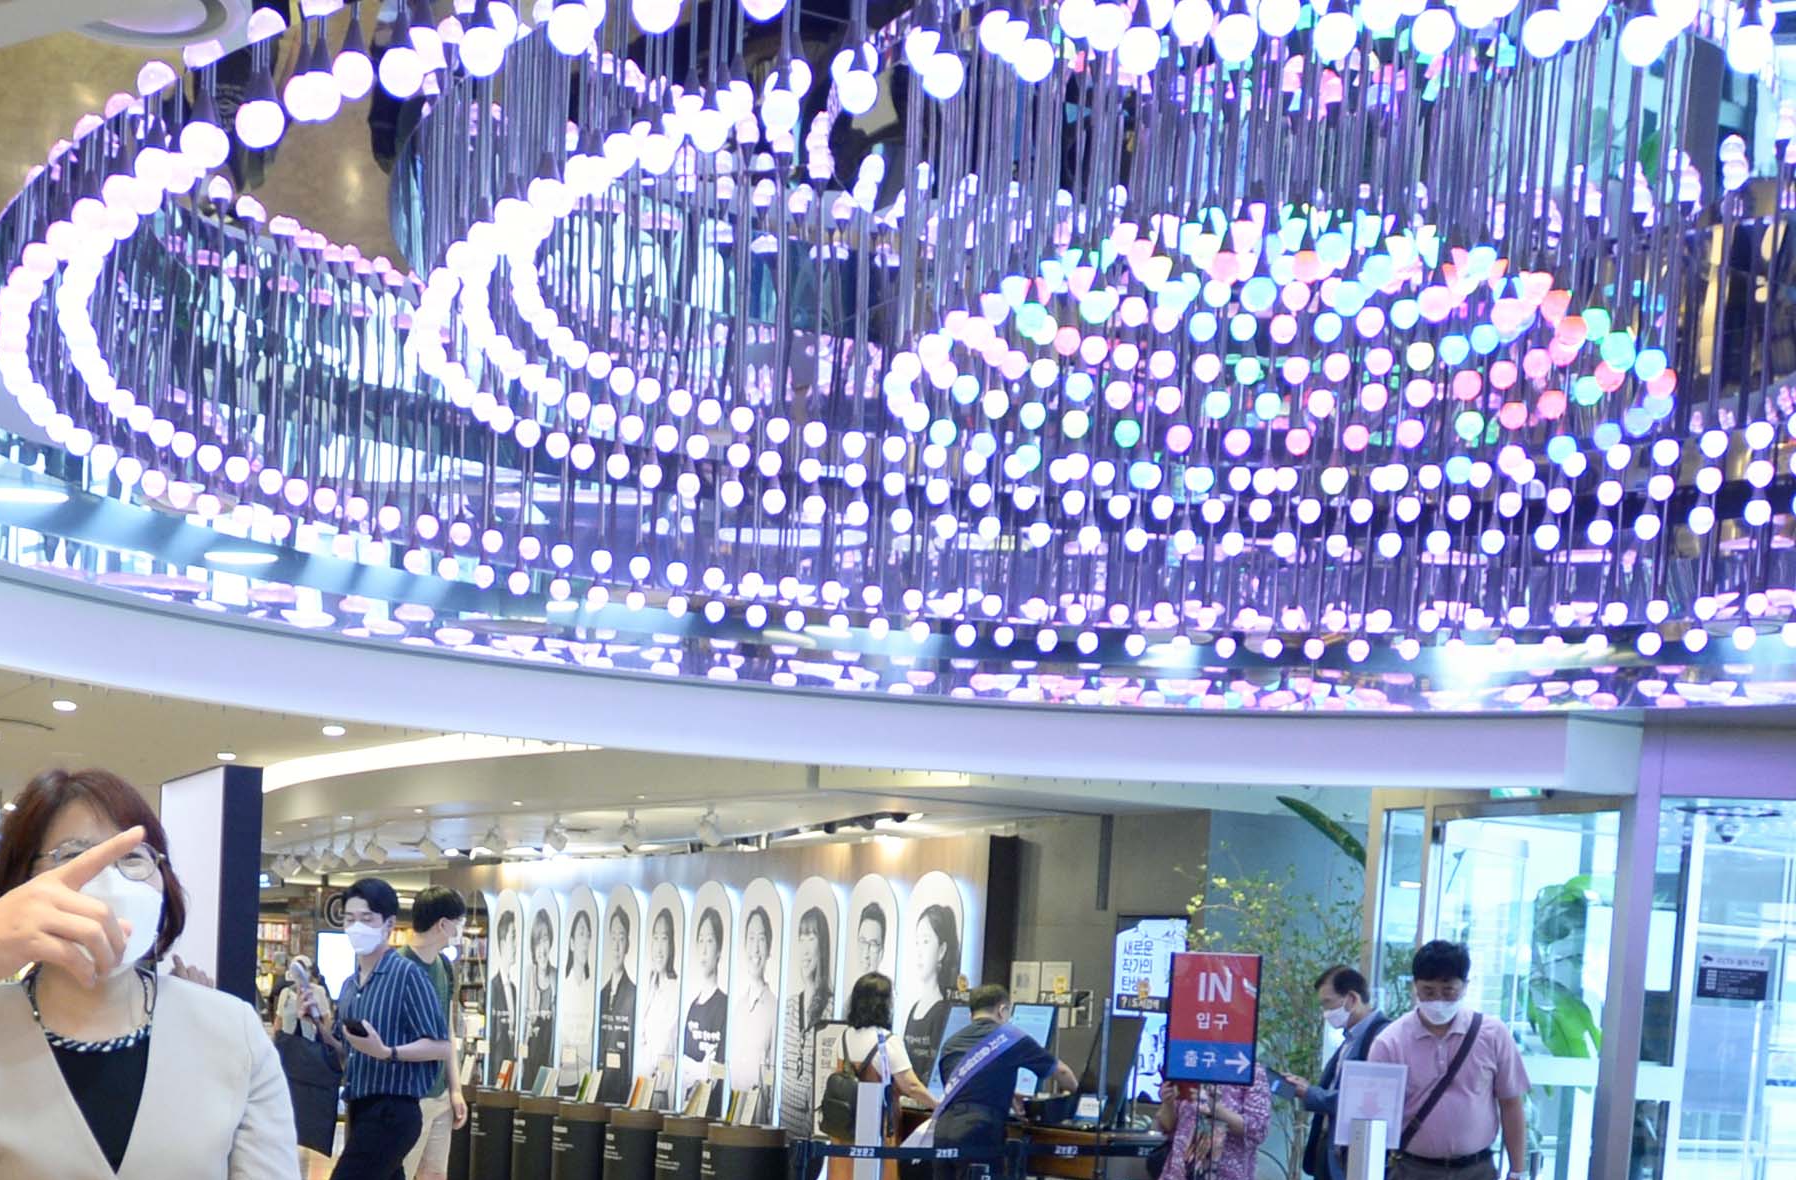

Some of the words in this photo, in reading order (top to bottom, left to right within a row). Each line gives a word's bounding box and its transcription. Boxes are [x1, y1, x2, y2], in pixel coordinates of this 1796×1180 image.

[1121, 976, 1151, 992] 탄생
[1198, 971, 1234, 1003] IN
[1196, 1011, 1229, 1030] 입구
[1184, 1050, 1217, 1068] 출구
